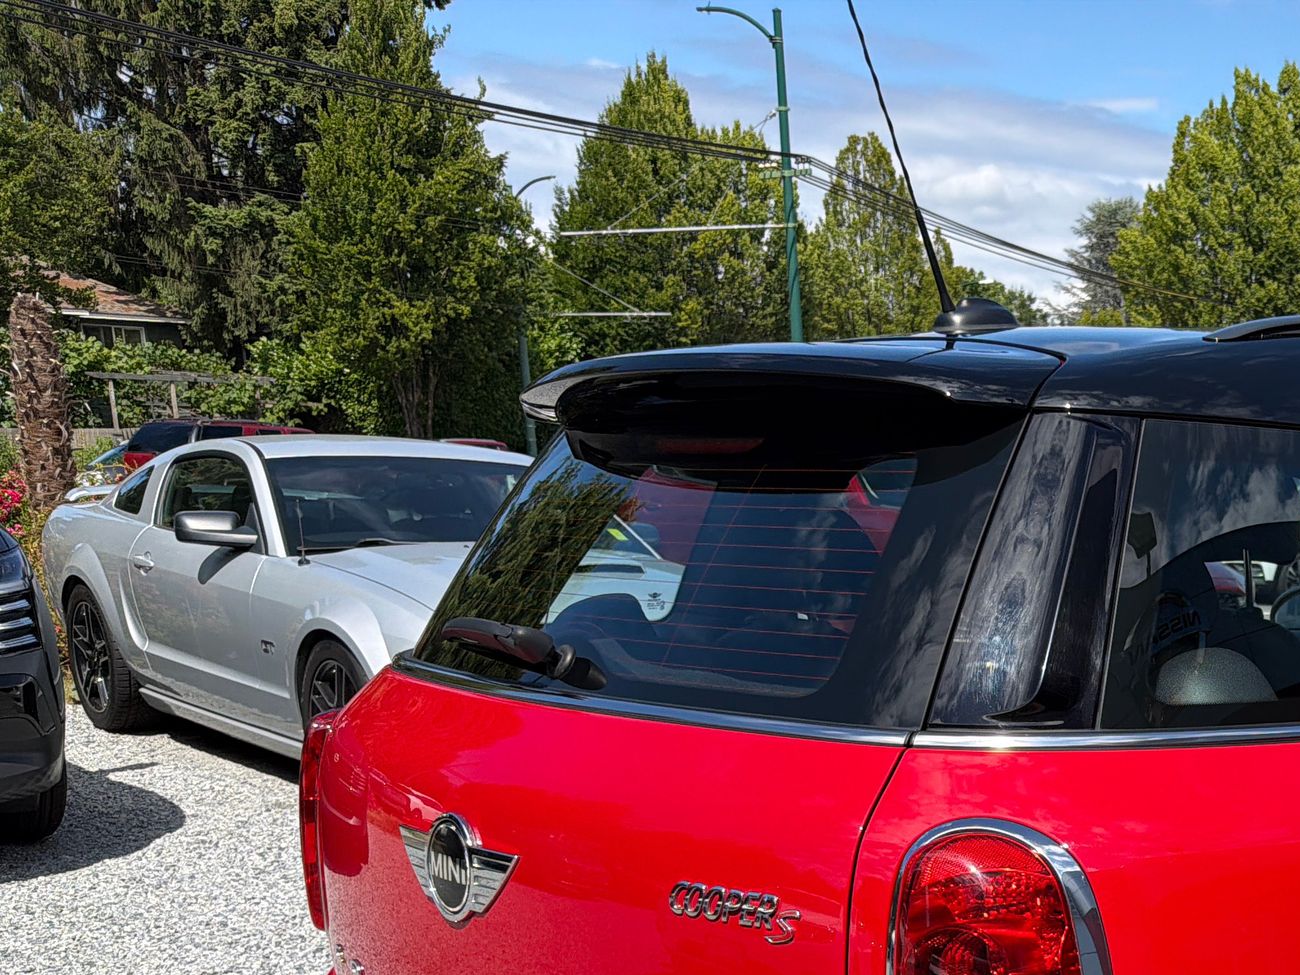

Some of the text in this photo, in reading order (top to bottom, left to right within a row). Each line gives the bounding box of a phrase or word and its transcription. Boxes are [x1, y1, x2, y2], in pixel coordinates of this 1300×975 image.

[429, 852, 469, 885] MINI
[669, 880, 802, 945] COOPER S
